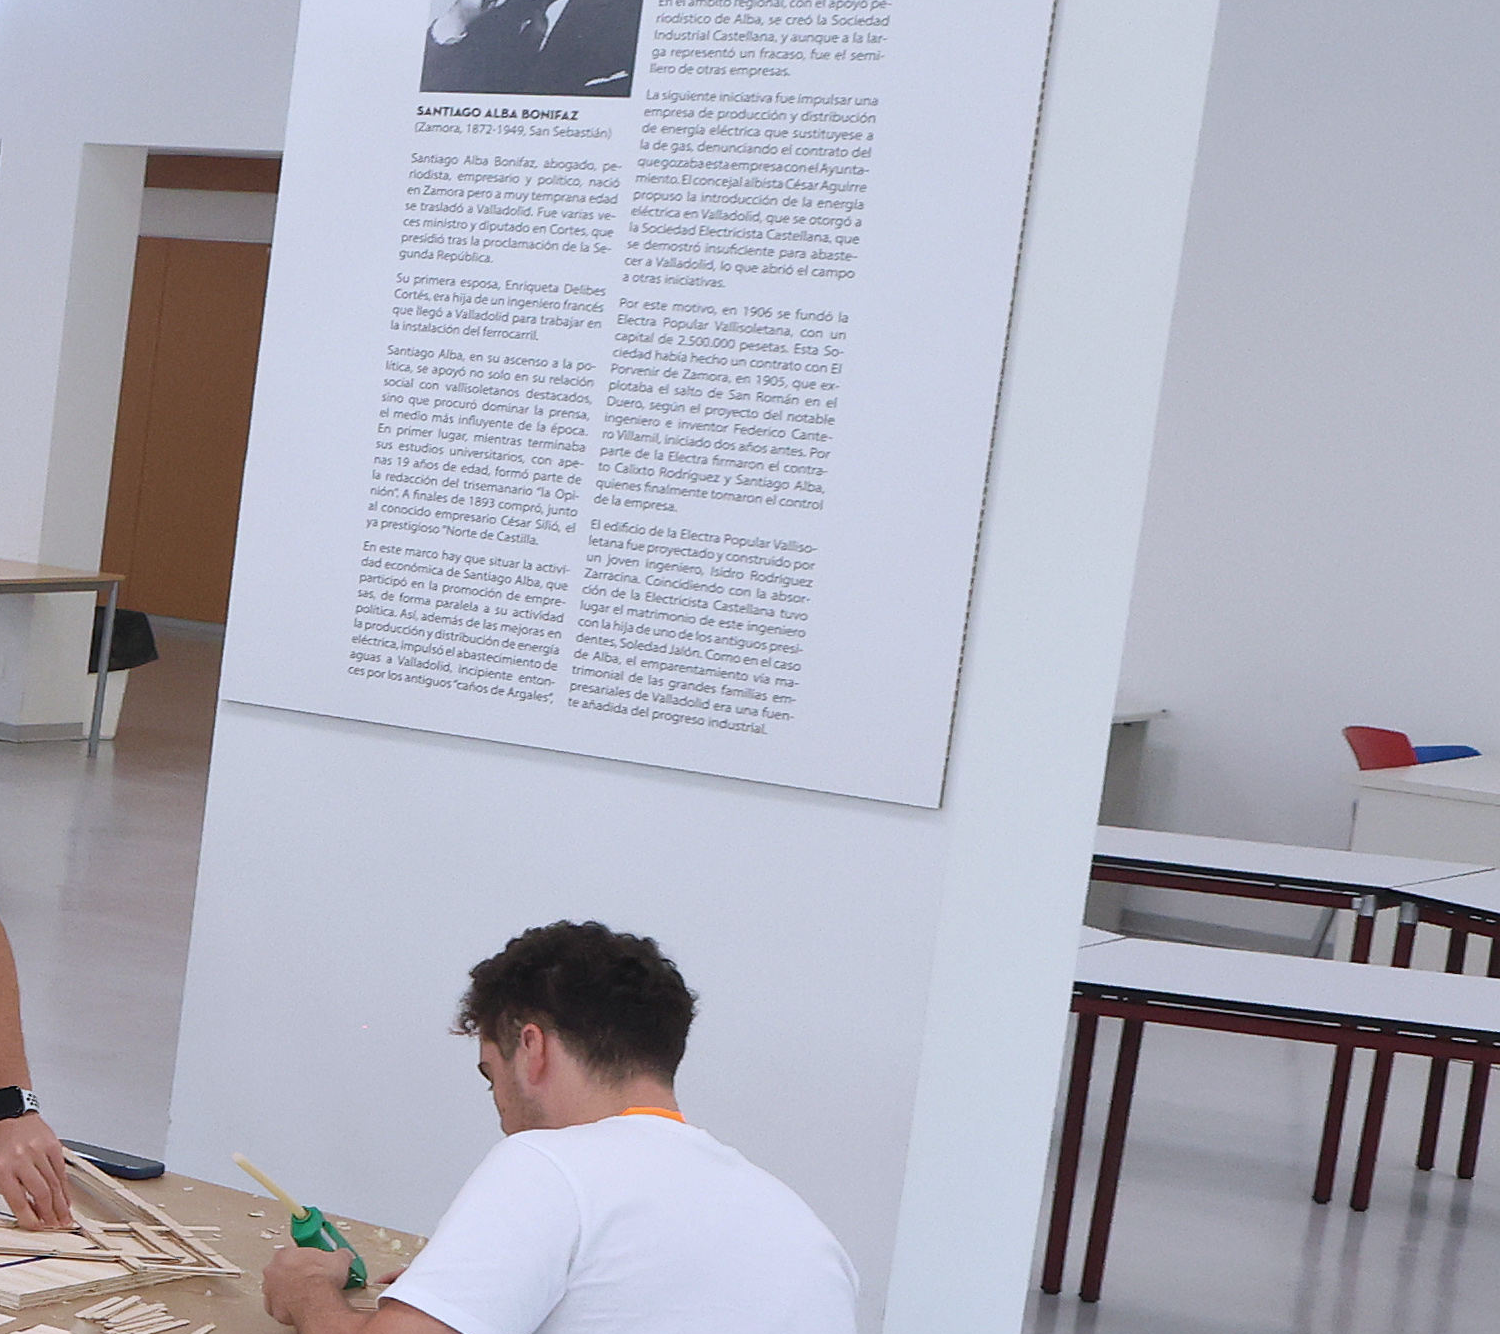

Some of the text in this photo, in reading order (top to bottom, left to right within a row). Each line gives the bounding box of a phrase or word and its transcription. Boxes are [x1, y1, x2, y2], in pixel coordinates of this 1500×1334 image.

[416, 105, 580, 121] SANTIAGO ALBA BONIFAZ
[414, 121, 613, 140] (Zamora, 1872-1949, San Sebastián)
[410, 152, 623, 174] Santiago Alba Bonifaz, abogado, pe-
[408, 168, 621, 188] riodista, empresario y político, nació
[406, 184, 620, 204] en Zamora pero a muy temprana edad
